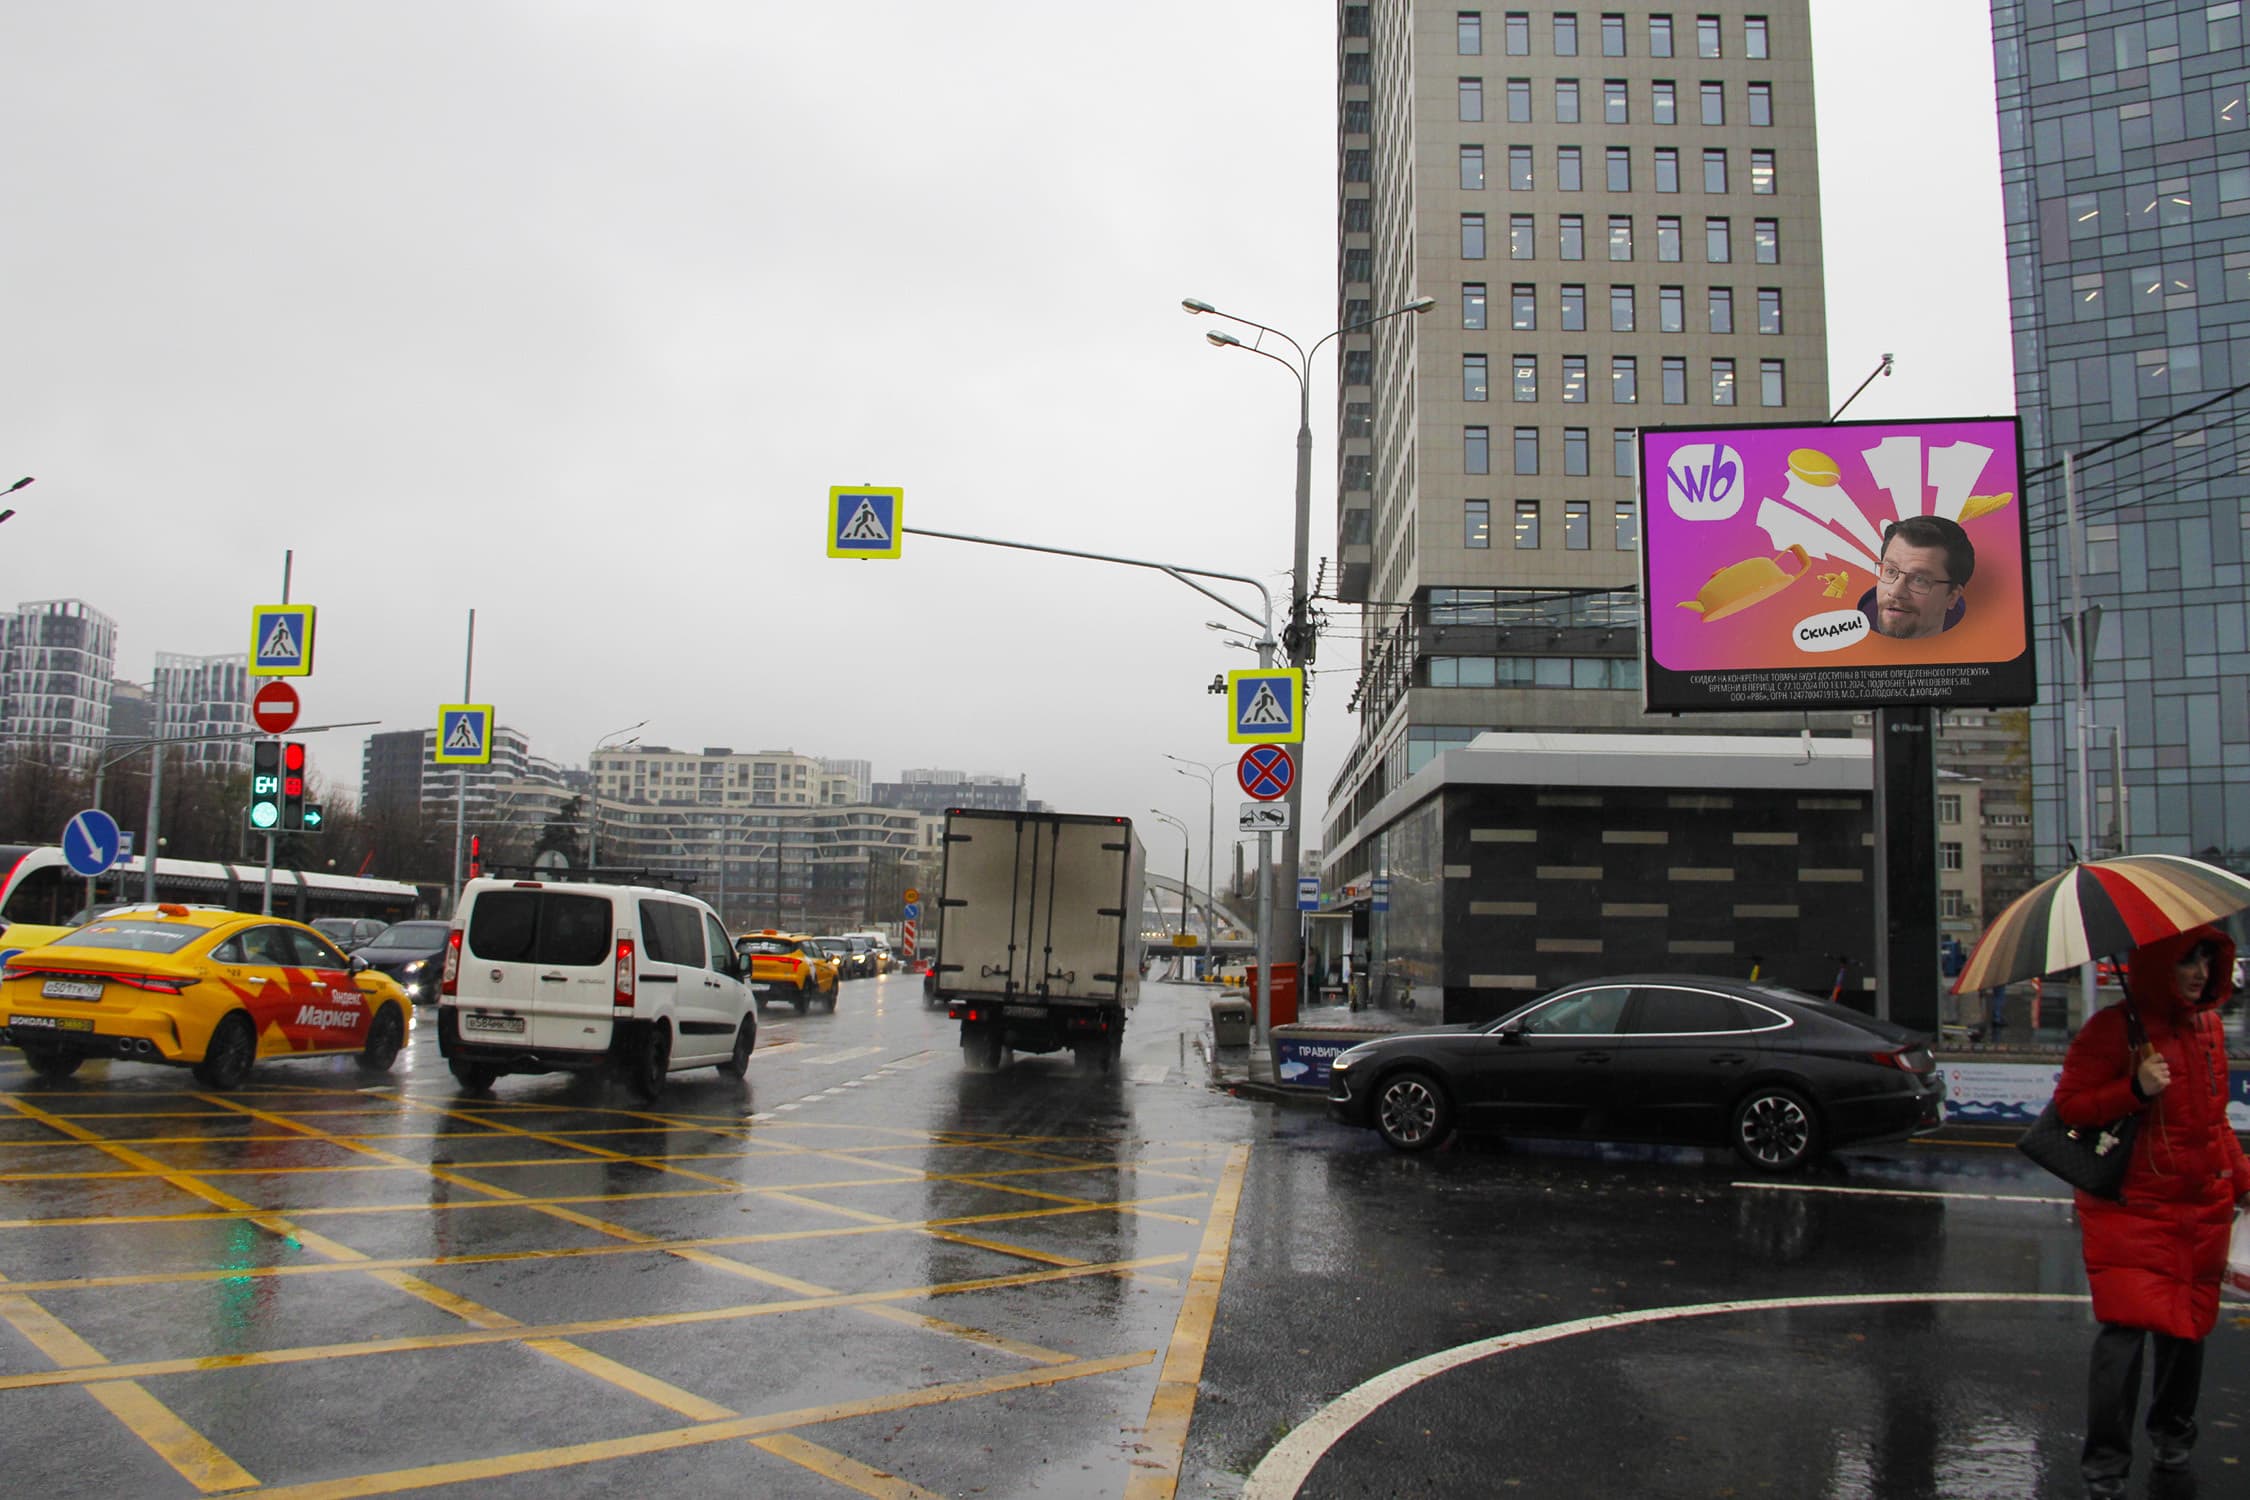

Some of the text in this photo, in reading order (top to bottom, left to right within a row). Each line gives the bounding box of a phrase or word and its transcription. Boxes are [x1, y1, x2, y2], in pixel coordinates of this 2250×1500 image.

[1690, 674, 1717, 685] СКИДКИ
[1718, 674, 1728, 683] НА
[1728, 672, 1769, 683] КОНКРЕТНЫЕ
[1771, 672, 1798, 682] ТОВАРЫ
[1799, 671, 1818, 682] БУДУТ
[1818, 671, 1854, 682] ДОСТУПНЫ
[1861, 670, 1888, 680] ТЕЧЕНИЕ
[1890, 669, 1945, 680] ОПРЕДЕЛЕННОГО
[1946, 667, 1990, 677] ПРОМЕЖУТКА
[1709, 683, 1741, 692] ВРЕМЕНИ
[1748, 682, 1775, 692] ПЕРИОД
[255, 776, 278, 794] 64
[332, 989, 361, 1005] Яндекс
[295, 1005, 361, 1030] Маркет
[1299, 1046, 1347, 1057] ПРАВИЛЬ
